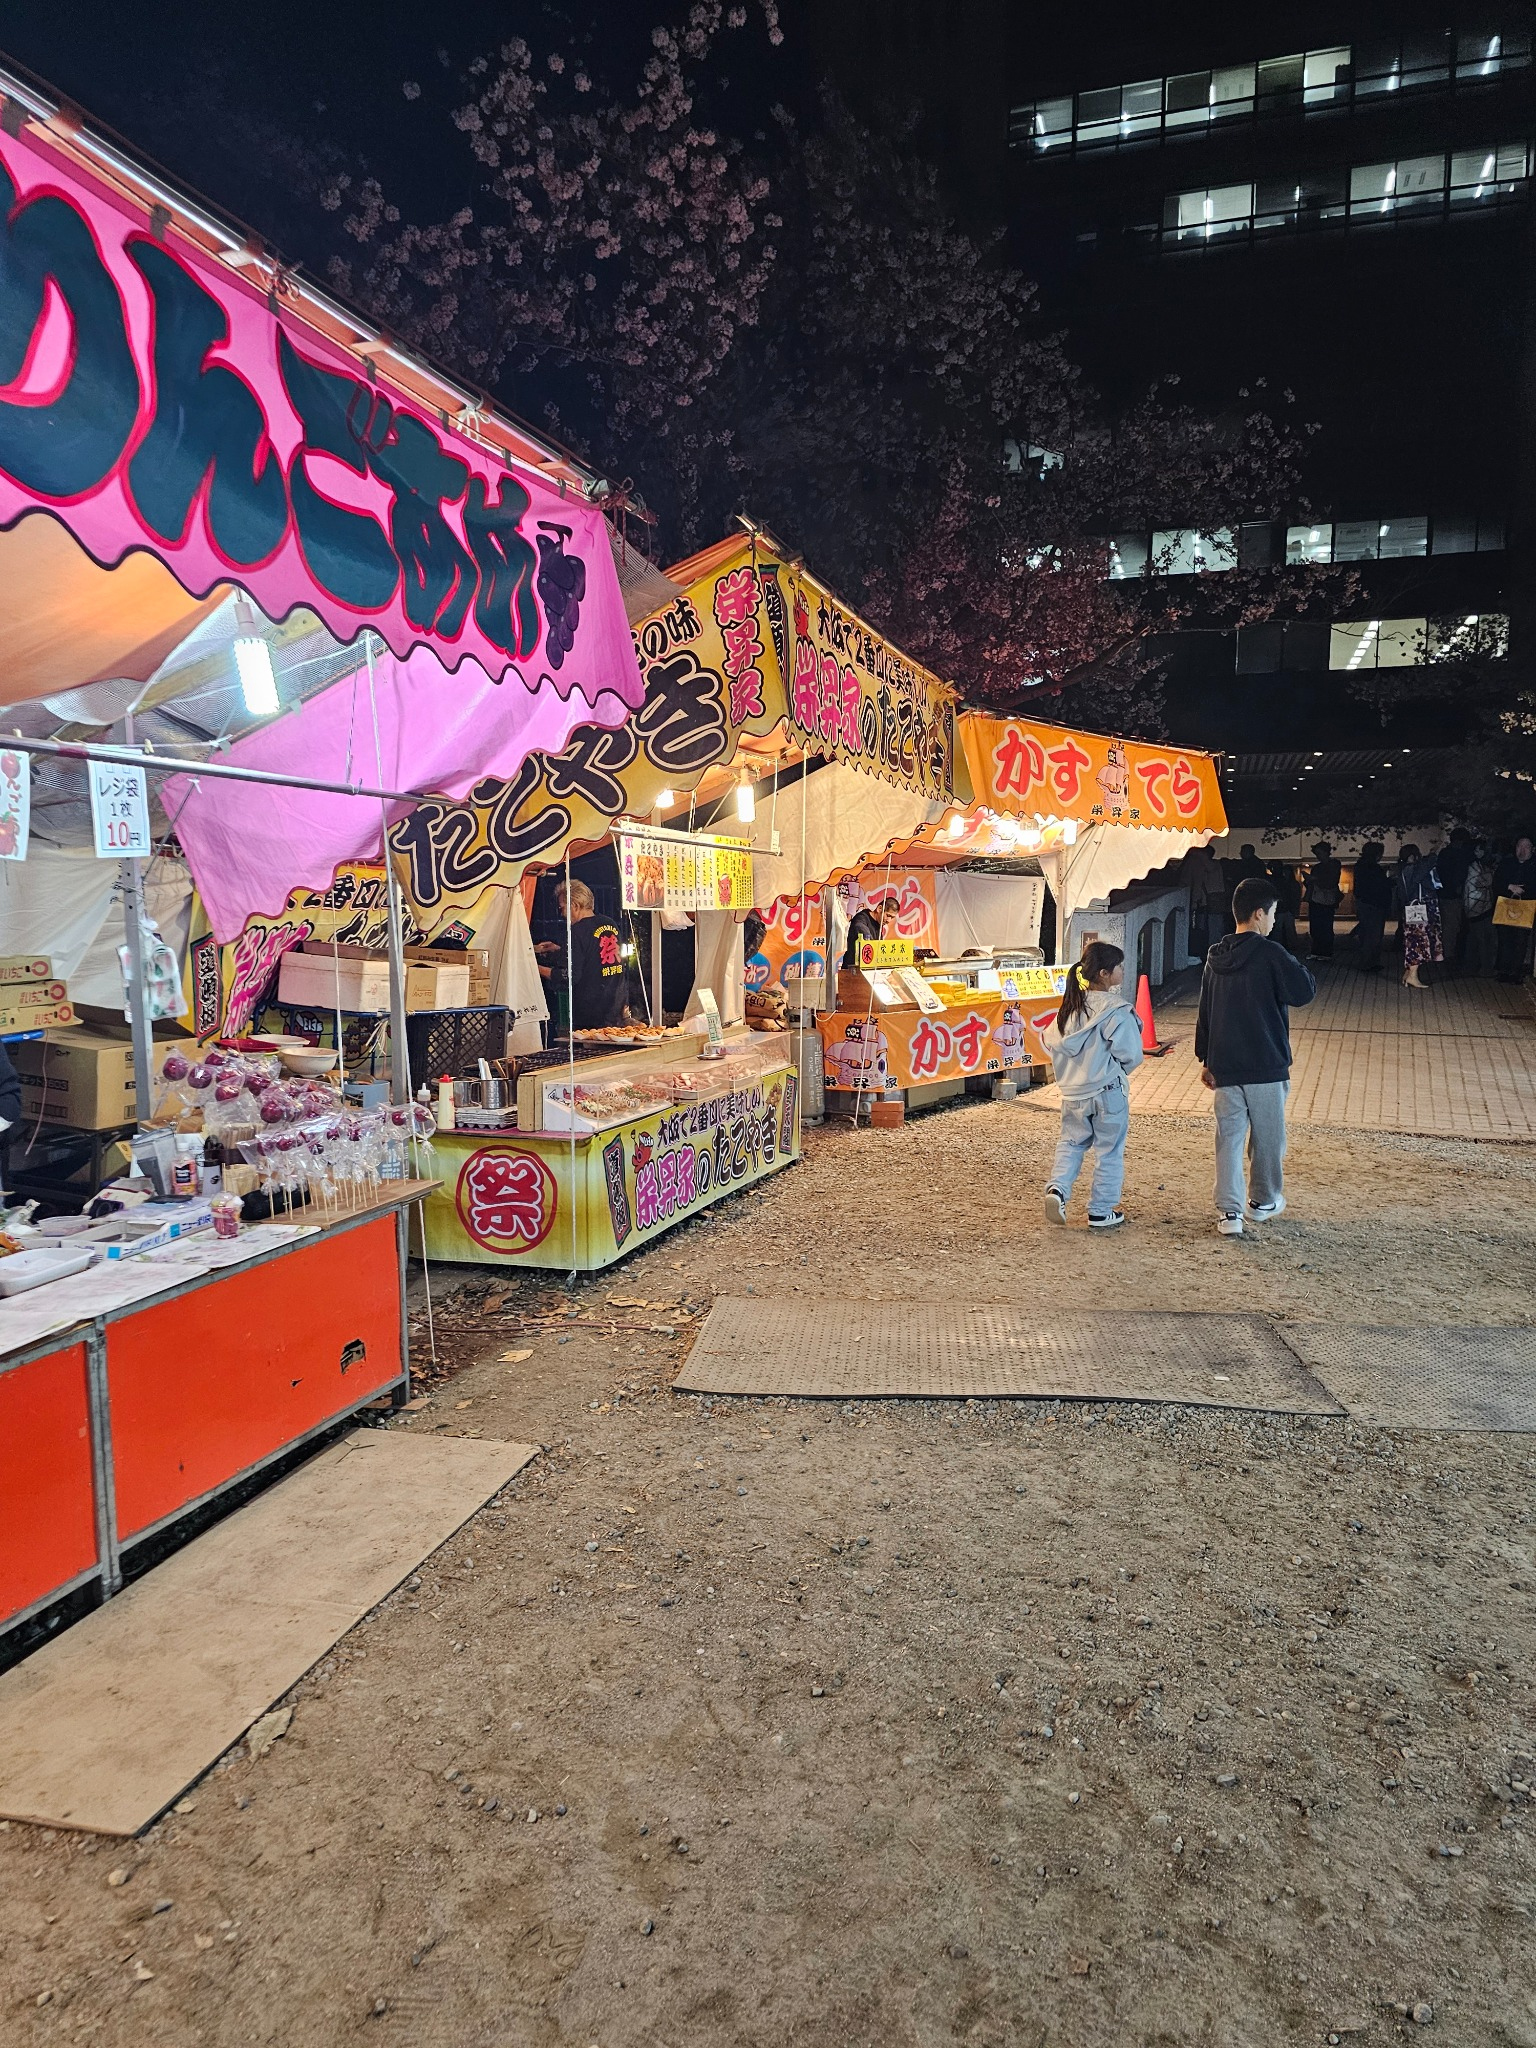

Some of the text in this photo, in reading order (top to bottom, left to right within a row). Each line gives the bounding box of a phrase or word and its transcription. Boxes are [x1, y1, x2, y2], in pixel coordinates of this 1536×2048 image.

[98, 776, 140, 797] レジ袋
[995, 727, 1090, 803] かす
[1136, 759, 1203, 815] てら
[110, 801, 134, 817] 1枚
[107, 821, 141, 847] 10円
[911, 1015, 989, 1075] かす
[467, 1155, 545, 1241] 祭
